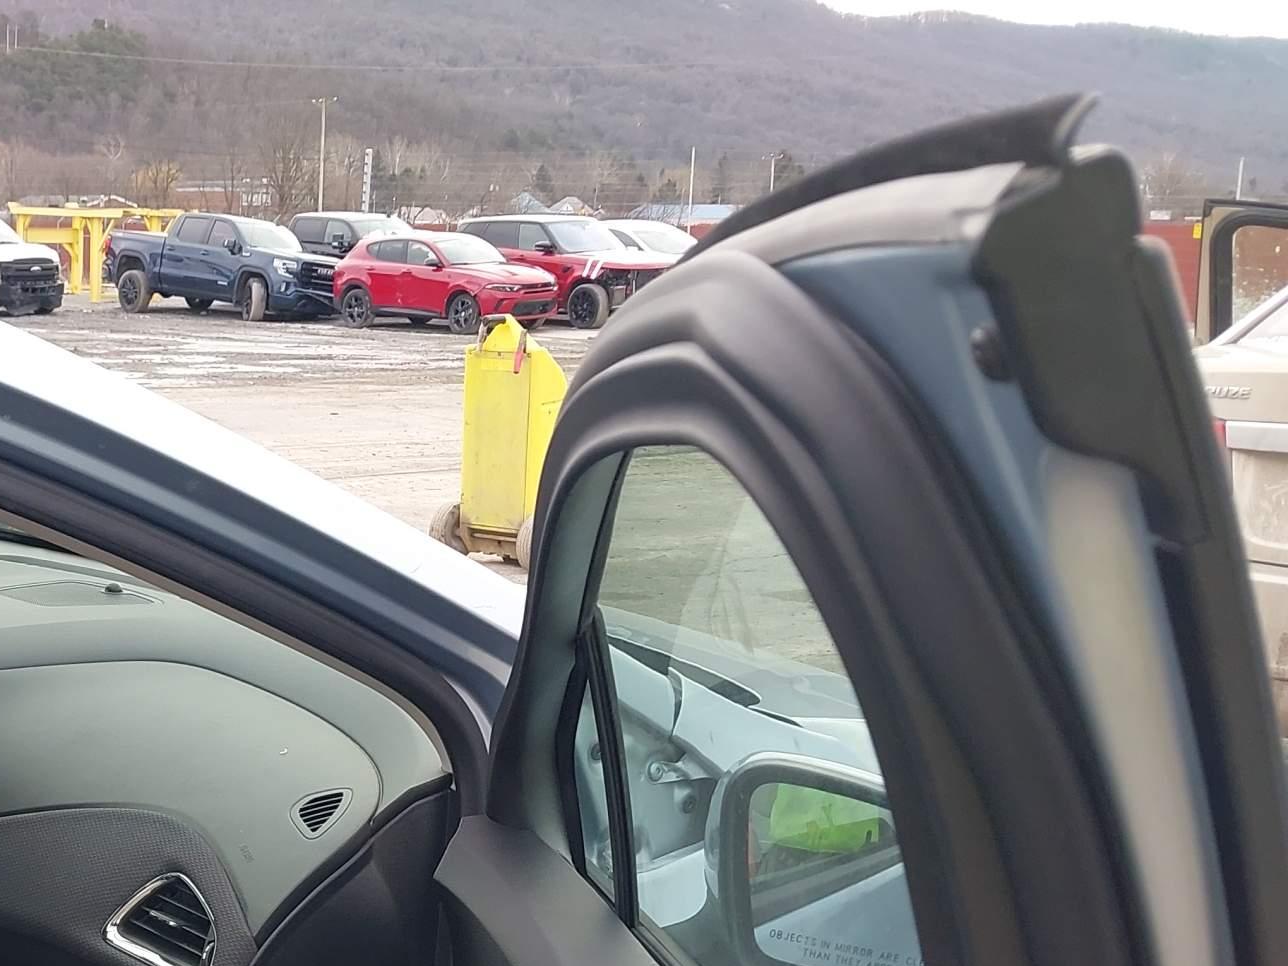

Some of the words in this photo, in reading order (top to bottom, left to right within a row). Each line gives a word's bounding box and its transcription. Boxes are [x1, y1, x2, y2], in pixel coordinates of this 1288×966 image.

[769, 928, 817, 947] OBJECTS
[821, 939, 831, 950] IN
[834, 943, 873, 959] MIRROR
[879, 951, 900, 963] ARE
[803, 947, 831, 961] THAN
